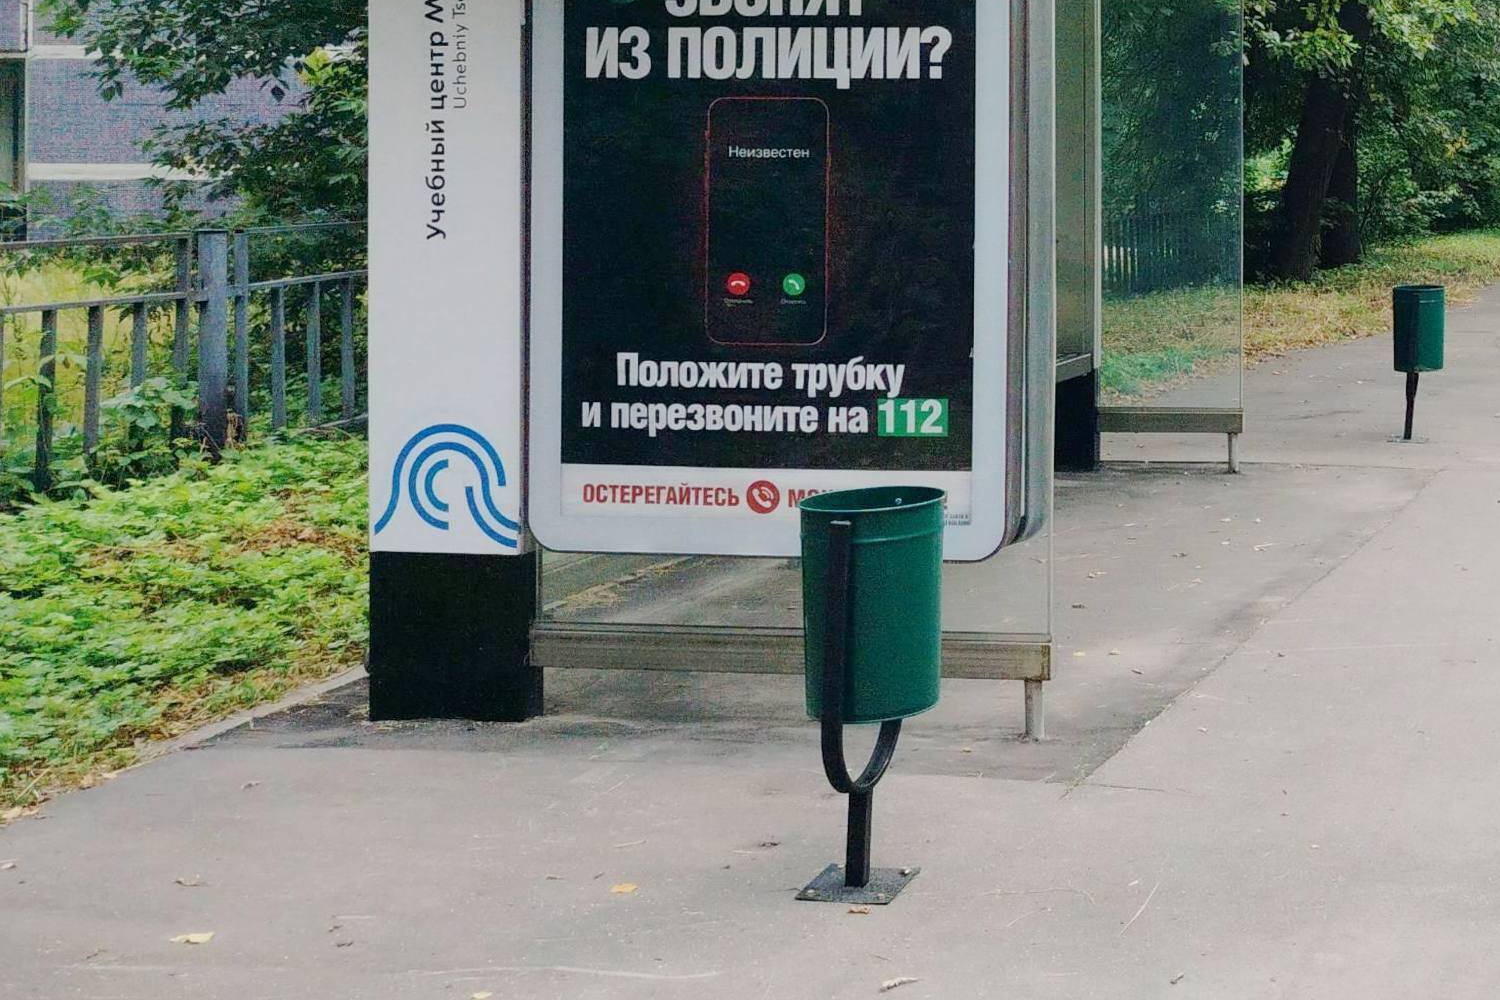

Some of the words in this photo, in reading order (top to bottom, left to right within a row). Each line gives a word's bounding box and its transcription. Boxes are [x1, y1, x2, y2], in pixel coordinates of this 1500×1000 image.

[429, 30, 449, 110] центр
[451, 23, 470, 109] Uchebniy
[585, 25, 651, 80] ИЗ
[667, 25, 953, 90] ПОЛИЦИИ?
[728, 144, 810, 159] Неизвестен
[424, 119, 447, 240] Учебный
[616, 352, 783, 390] Положите
[791, 356, 905, 398] трубку
[581, 401, 601, 428] и
[611, 402, 819, 437] перезвоните
[827, 406, 869, 433] на
[878, 399, 943, 433] 112
[582, 481, 740, 507] ОСТЕРЕГАЙТЕСЬ
